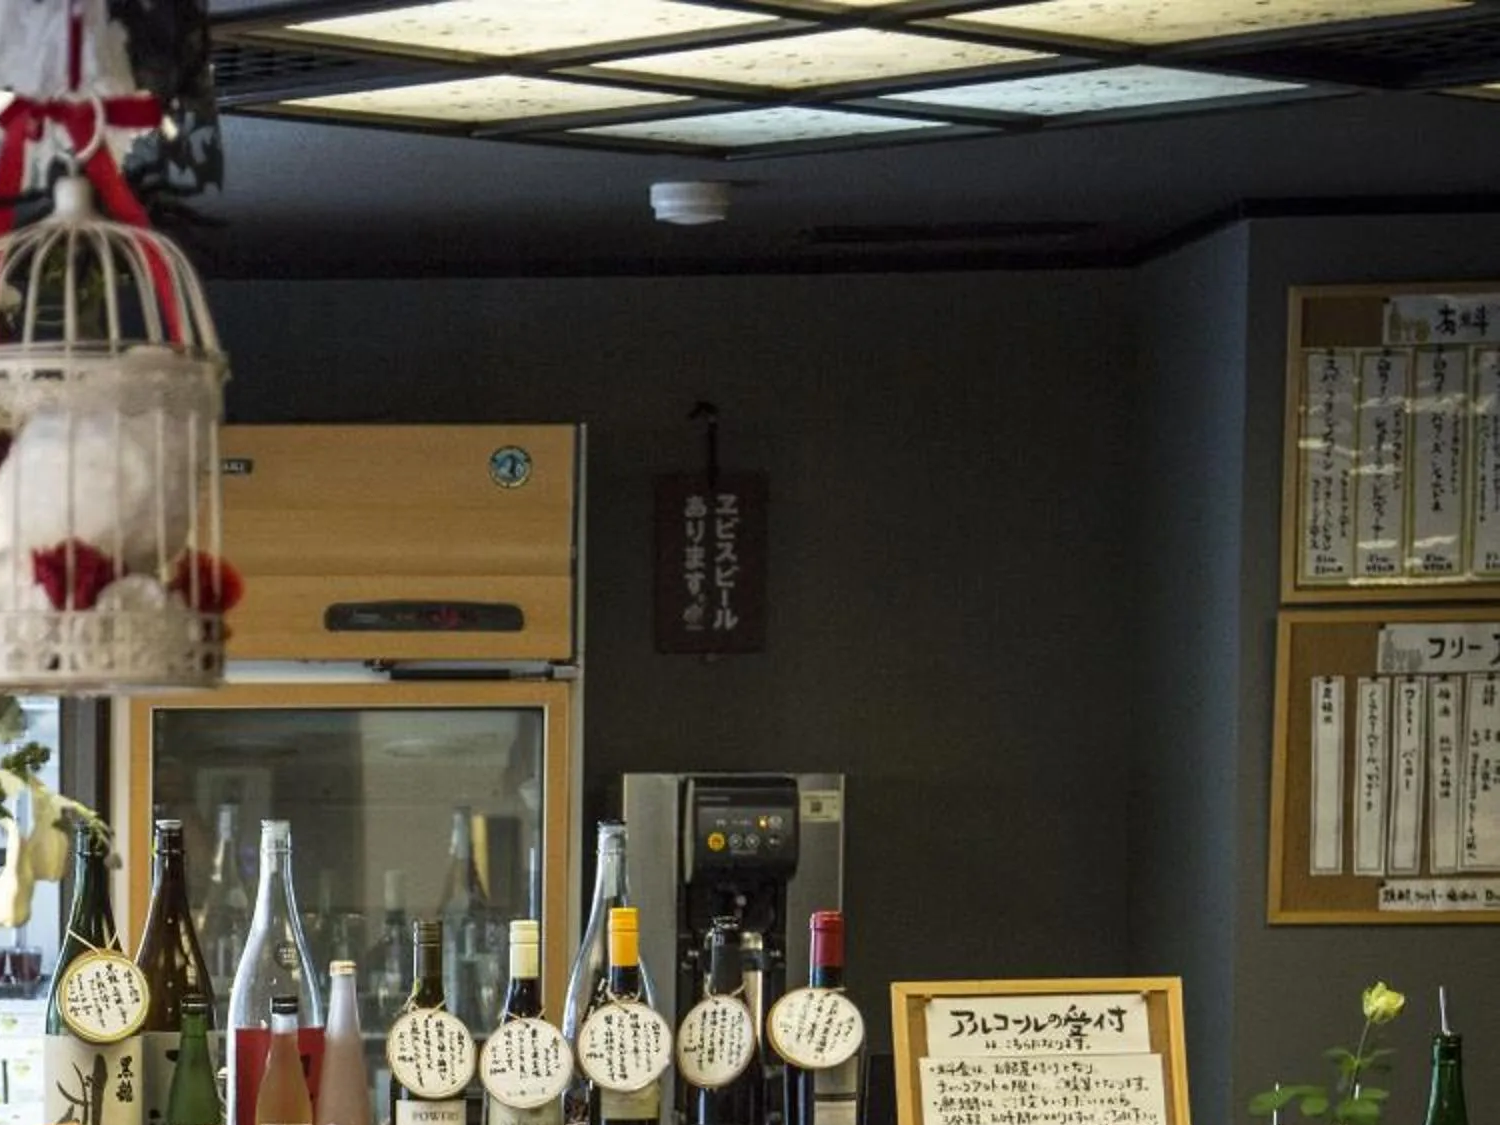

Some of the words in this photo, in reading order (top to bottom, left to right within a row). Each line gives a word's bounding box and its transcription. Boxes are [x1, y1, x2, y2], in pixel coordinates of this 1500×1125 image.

[949, 1004, 1128, 1038] アルコールの受付
